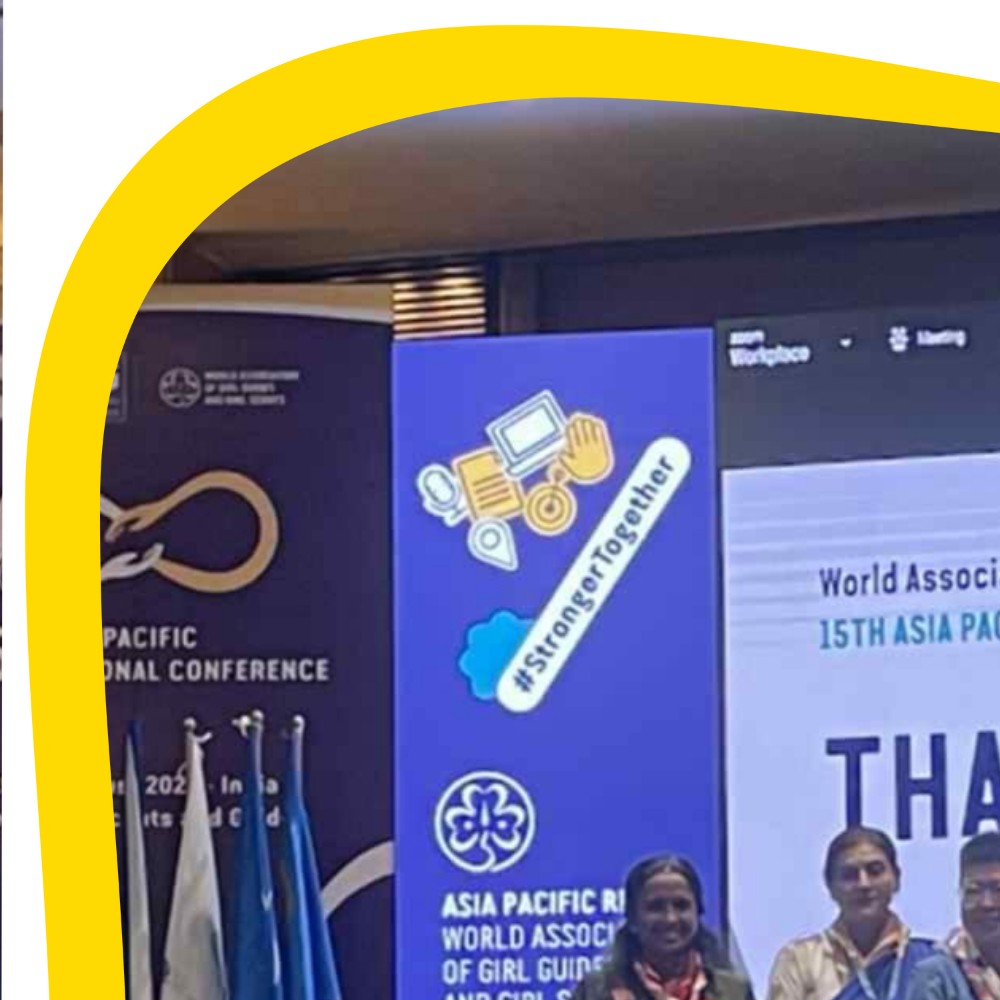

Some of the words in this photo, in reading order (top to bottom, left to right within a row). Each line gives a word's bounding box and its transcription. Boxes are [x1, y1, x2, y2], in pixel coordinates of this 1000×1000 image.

[512, 454, 676, 694] #StrongerTogether
[819, 562, 898, 597] World
[102, 626, 198, 649] PACIFIC
[819, 616, 885, 650] 15TH
[893, 613, 952, 646] ASIA
[168, 658, 330, 682] CONFERENCE
[441, 891, 498, 919] ASIA
[502, 887, 597, 917] PACIFIC
[441, 923, 525, 952] WORLD
[530, 917, 620, 950] ASSOCI
[441, 957, 474, 985] OF
[478, 955, 531, 984] GIRL
